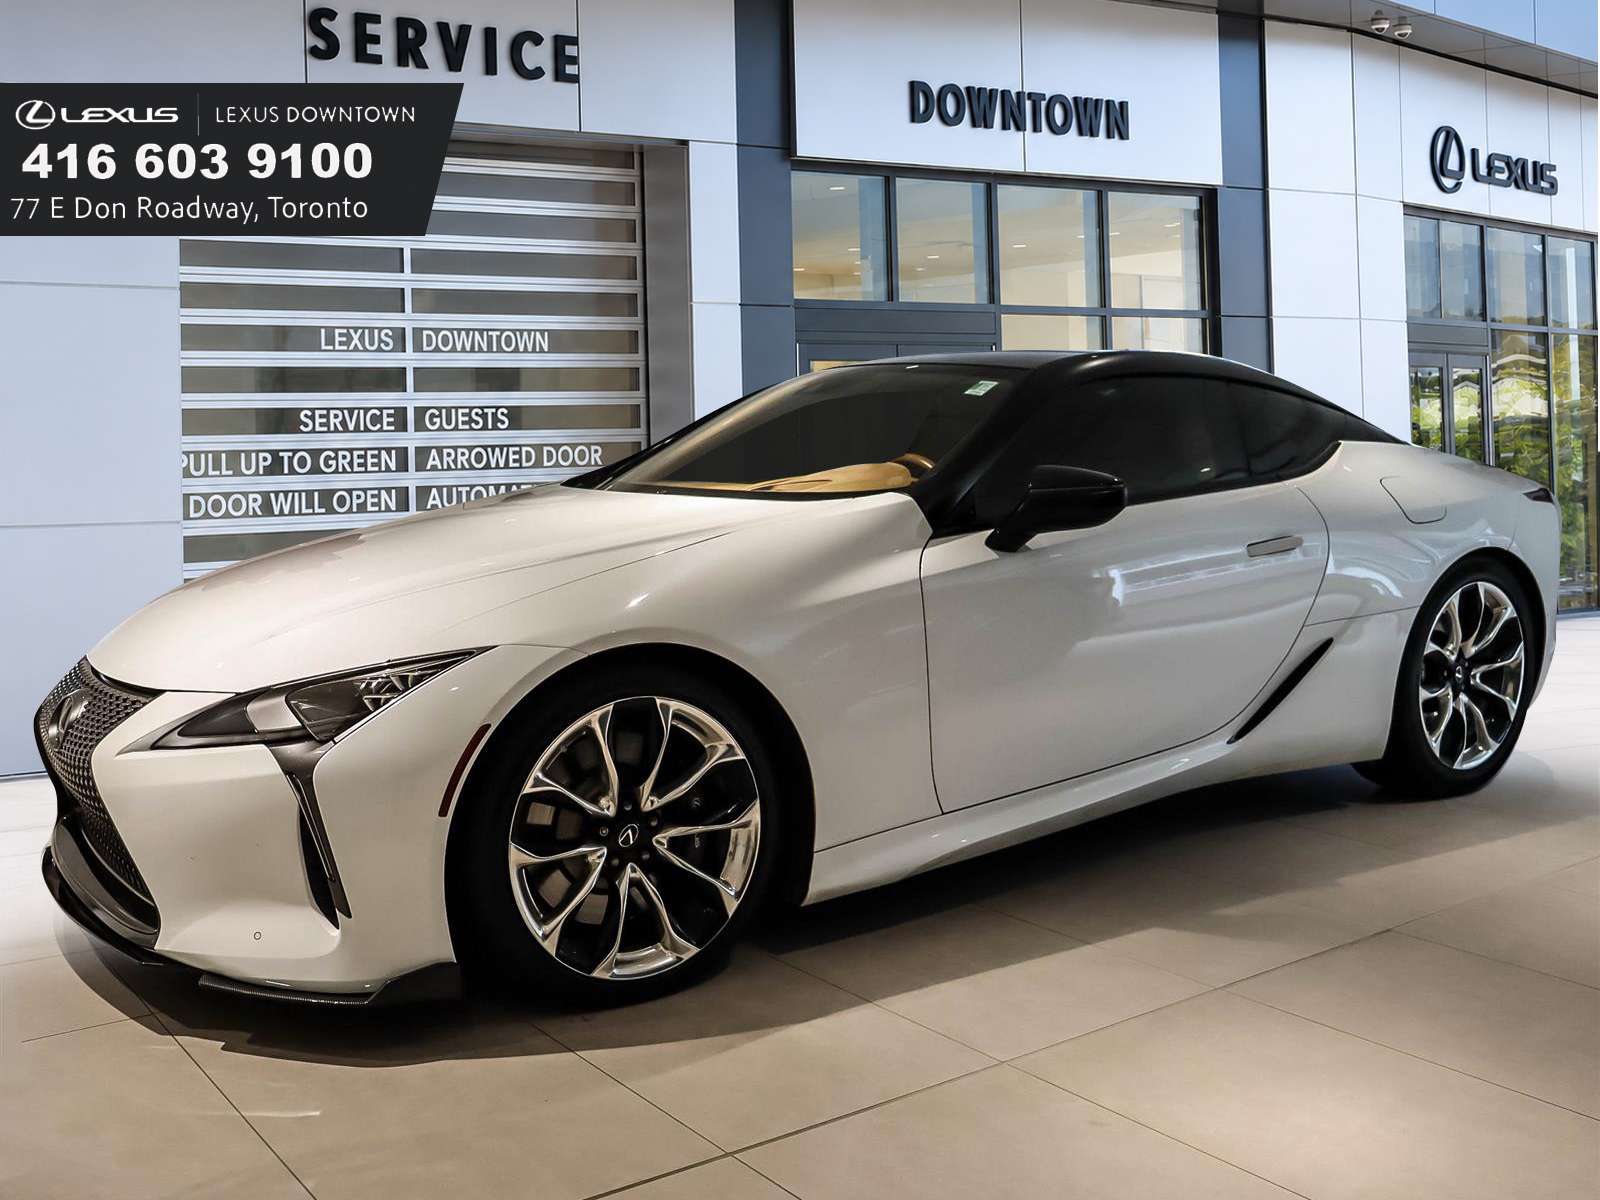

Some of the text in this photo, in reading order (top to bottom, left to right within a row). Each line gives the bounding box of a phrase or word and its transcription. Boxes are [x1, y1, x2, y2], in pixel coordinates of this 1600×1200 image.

[308, 7, 579, 83] SERVICE
[909, 80, 1129, 140] DOWNTOWN
[1470, 147, 1558, 196] LEXUS
[320, 328, 549, 352] LEXUS DOWNTOWN
[299, 408, 510, 432] SERVICE GUESTS
[240, 451, 272, 475] UP
[279, 450, 312, 474] TO
[319, 450, 397, 473] GREEN
[426, 446, 535, 470] ARROWED
[543, 445, 602, 467] DOOR
[189, 493, 263, 518] DOOR
[270, 491, 326, 515] WILL
[332, 489, 397, 513] OPEN
